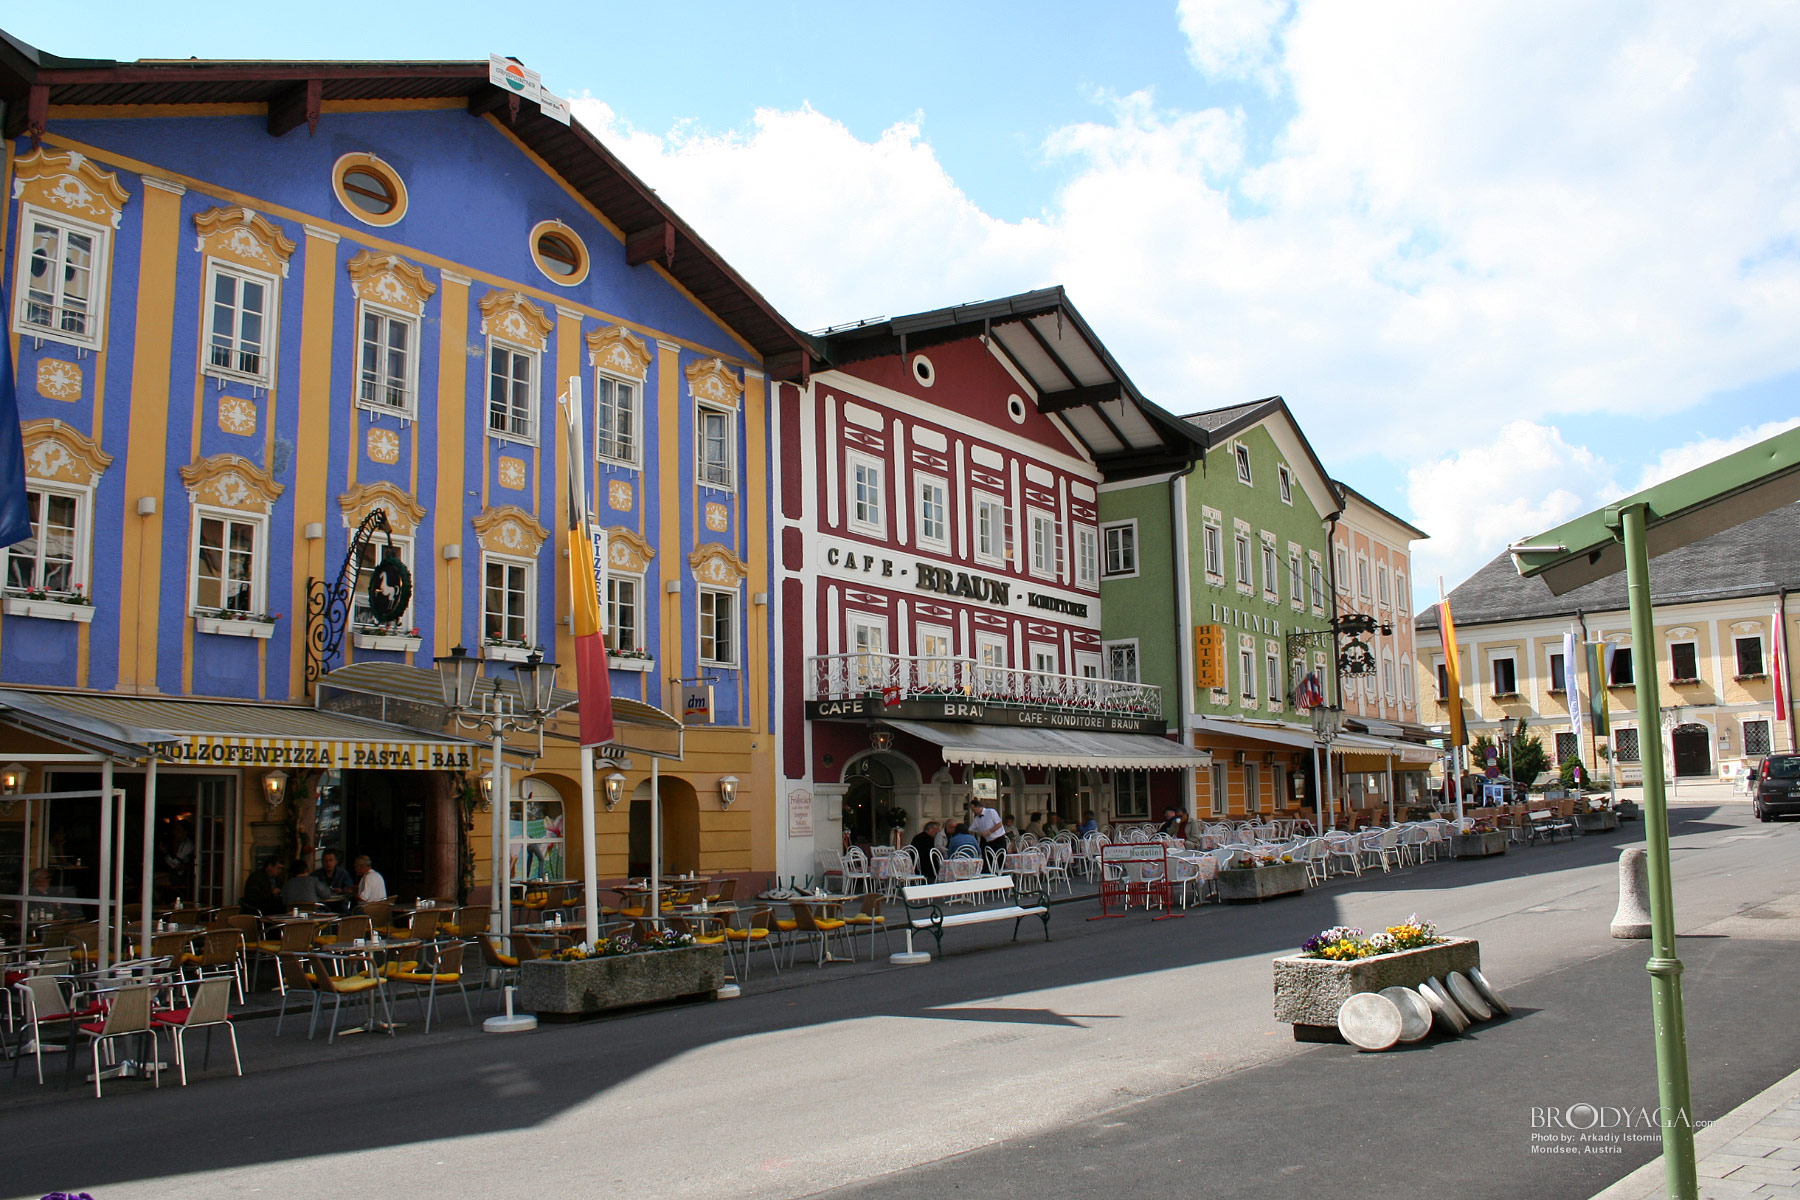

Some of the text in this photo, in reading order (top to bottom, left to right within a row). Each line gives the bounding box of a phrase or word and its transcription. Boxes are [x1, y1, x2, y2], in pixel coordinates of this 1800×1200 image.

[827, 547, 893, 577] CAFE
[916, 563, 1010, 606] BRAUN
[1210, 602, 1280, 638] LEITNER
[1200, 625, 1212, 680] HOTEL
[688, 694, 705, 709] dm
[818, 700, 864, 716] CAFE
[1018, 711, 1140, 730] CAFE KONDITOREI BRAUN
[154, 742, 470, 767] HOLZOFENPIZZA PASTA BAR
